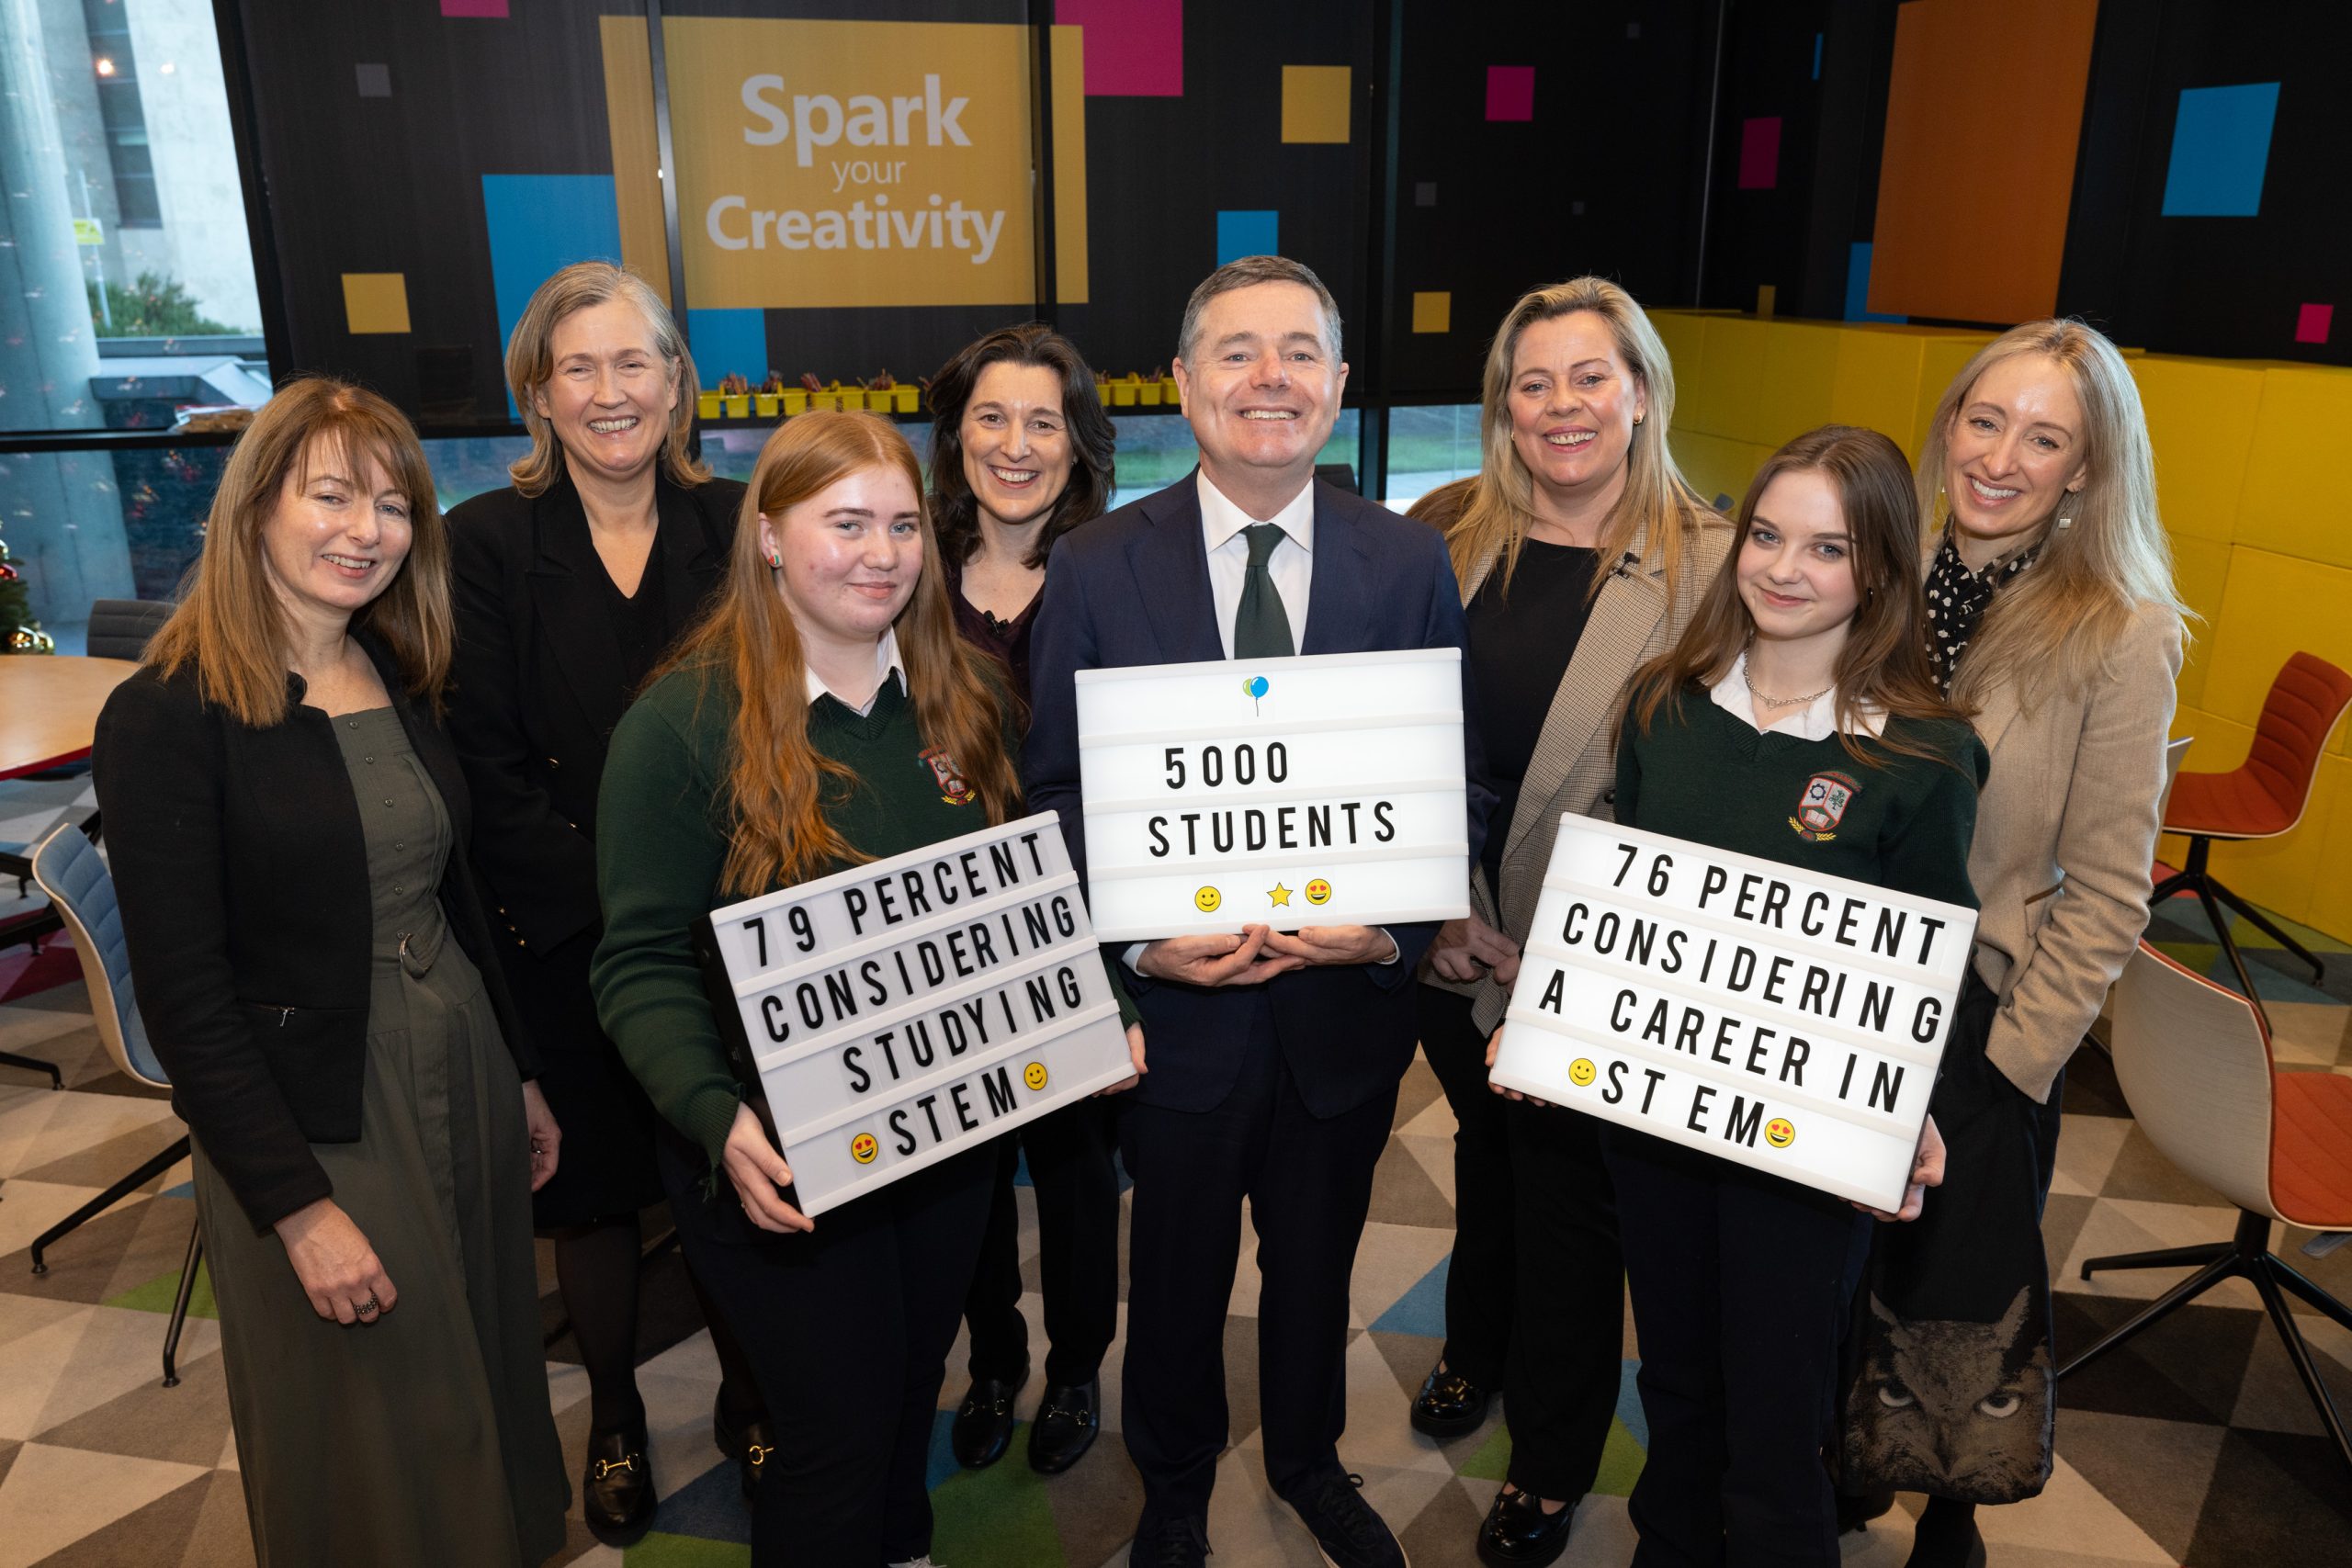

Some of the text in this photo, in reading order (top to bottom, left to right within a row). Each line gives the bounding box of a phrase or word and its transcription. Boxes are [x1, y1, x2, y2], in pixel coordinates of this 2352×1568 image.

[740, 73, 972, 167] Spark
[705, 193, 1005, 265] Creativity
[831, 160, 907, 193] your
[1164, 740, 1288, 790] 5000
[1148, 800, 1396, 858] STUDENTS
[742, 832, 1044, 967] 79 PERCENT
[1612, 843, 1946, 965] 76 PERCENT
[760, 896, 1075, 1043] CONSIDERING
[1562, 902, 1942, 1043] CONSIDERING
[842, 966, 1081, 1094] STUDYING
[1538, 968, 1905, 1113] A CAREER IN
[888, 1066, 1018, 1156] STEM
